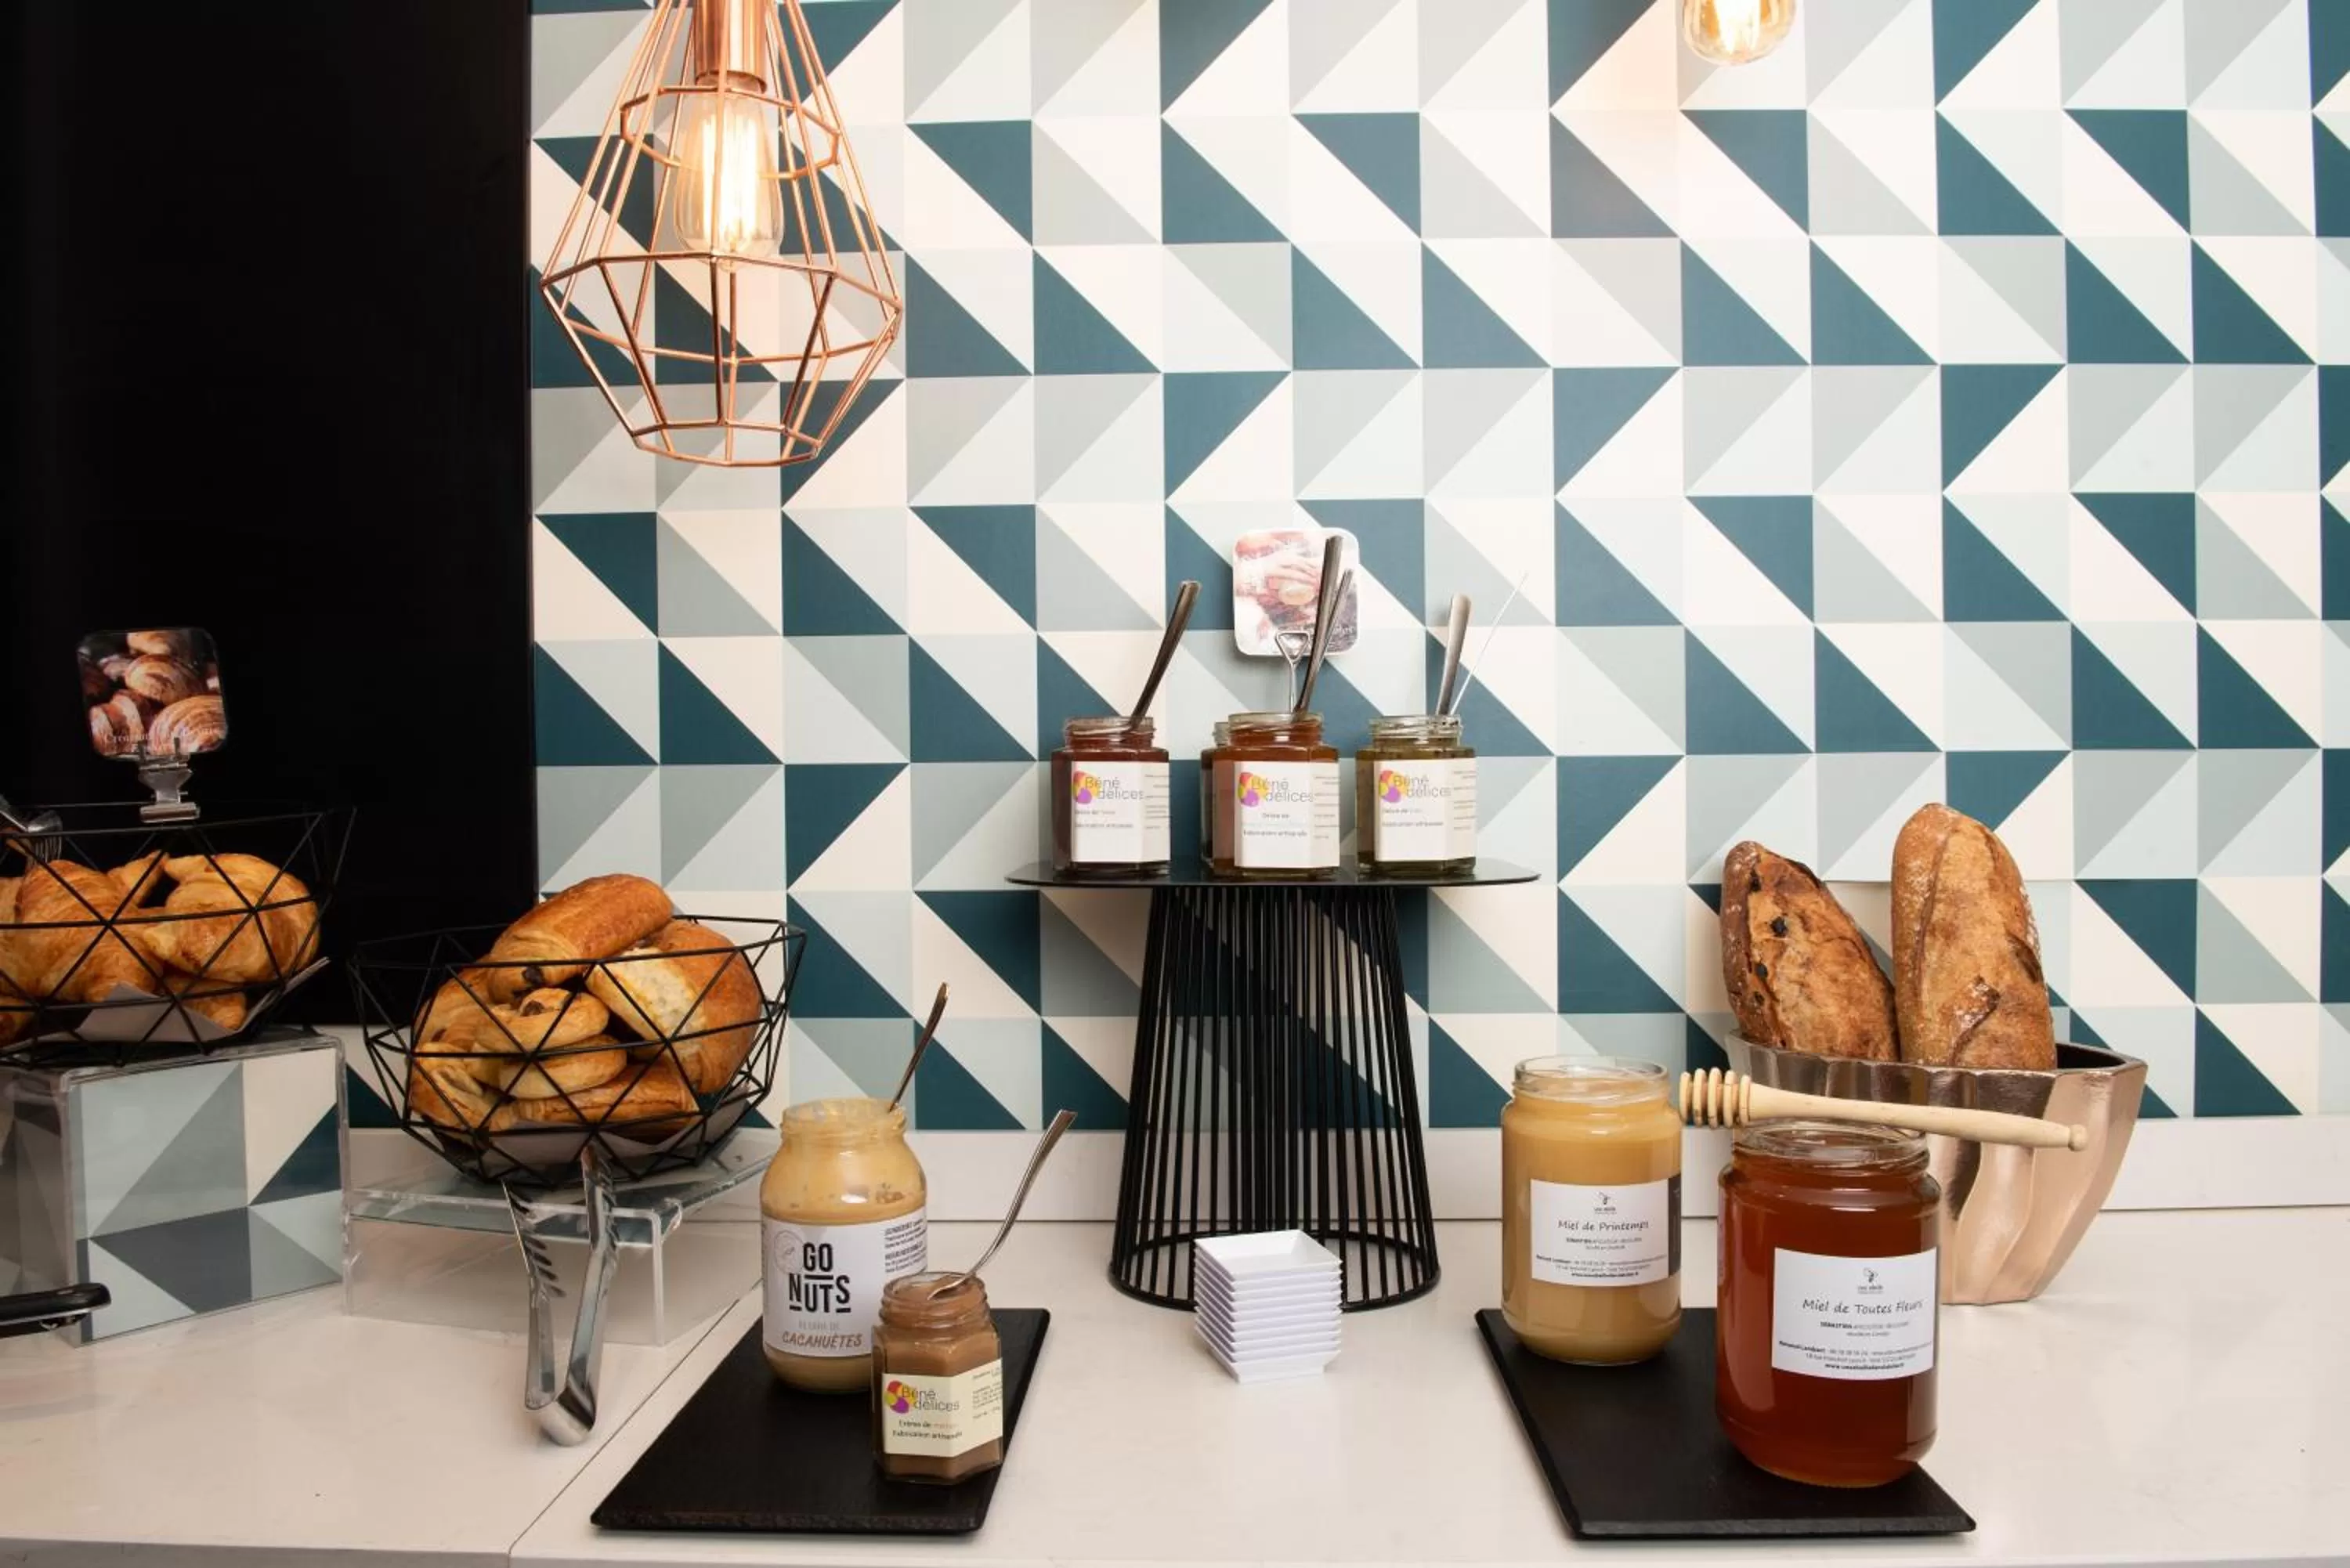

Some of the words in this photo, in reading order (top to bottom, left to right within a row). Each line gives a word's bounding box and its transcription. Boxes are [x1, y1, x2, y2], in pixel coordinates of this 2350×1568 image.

[1557, 1219, 1579, 1231] Miel
[1582, 1221, 1595, 1232] de
[803, 1242, 833, 1272] GO
[789, 1273, 850, 1313] NUTS
[1802, 1299, 1829, 1313] Miel
[1834, 1302, 1849, 1314] de
[1854, 1303, 1892, 1315] Toutes
[1896, 1299, 1923, 1313] Fleurs
[902, 1384, 937, 1400] Béné
[913, 1399, 960, 1412] délices
